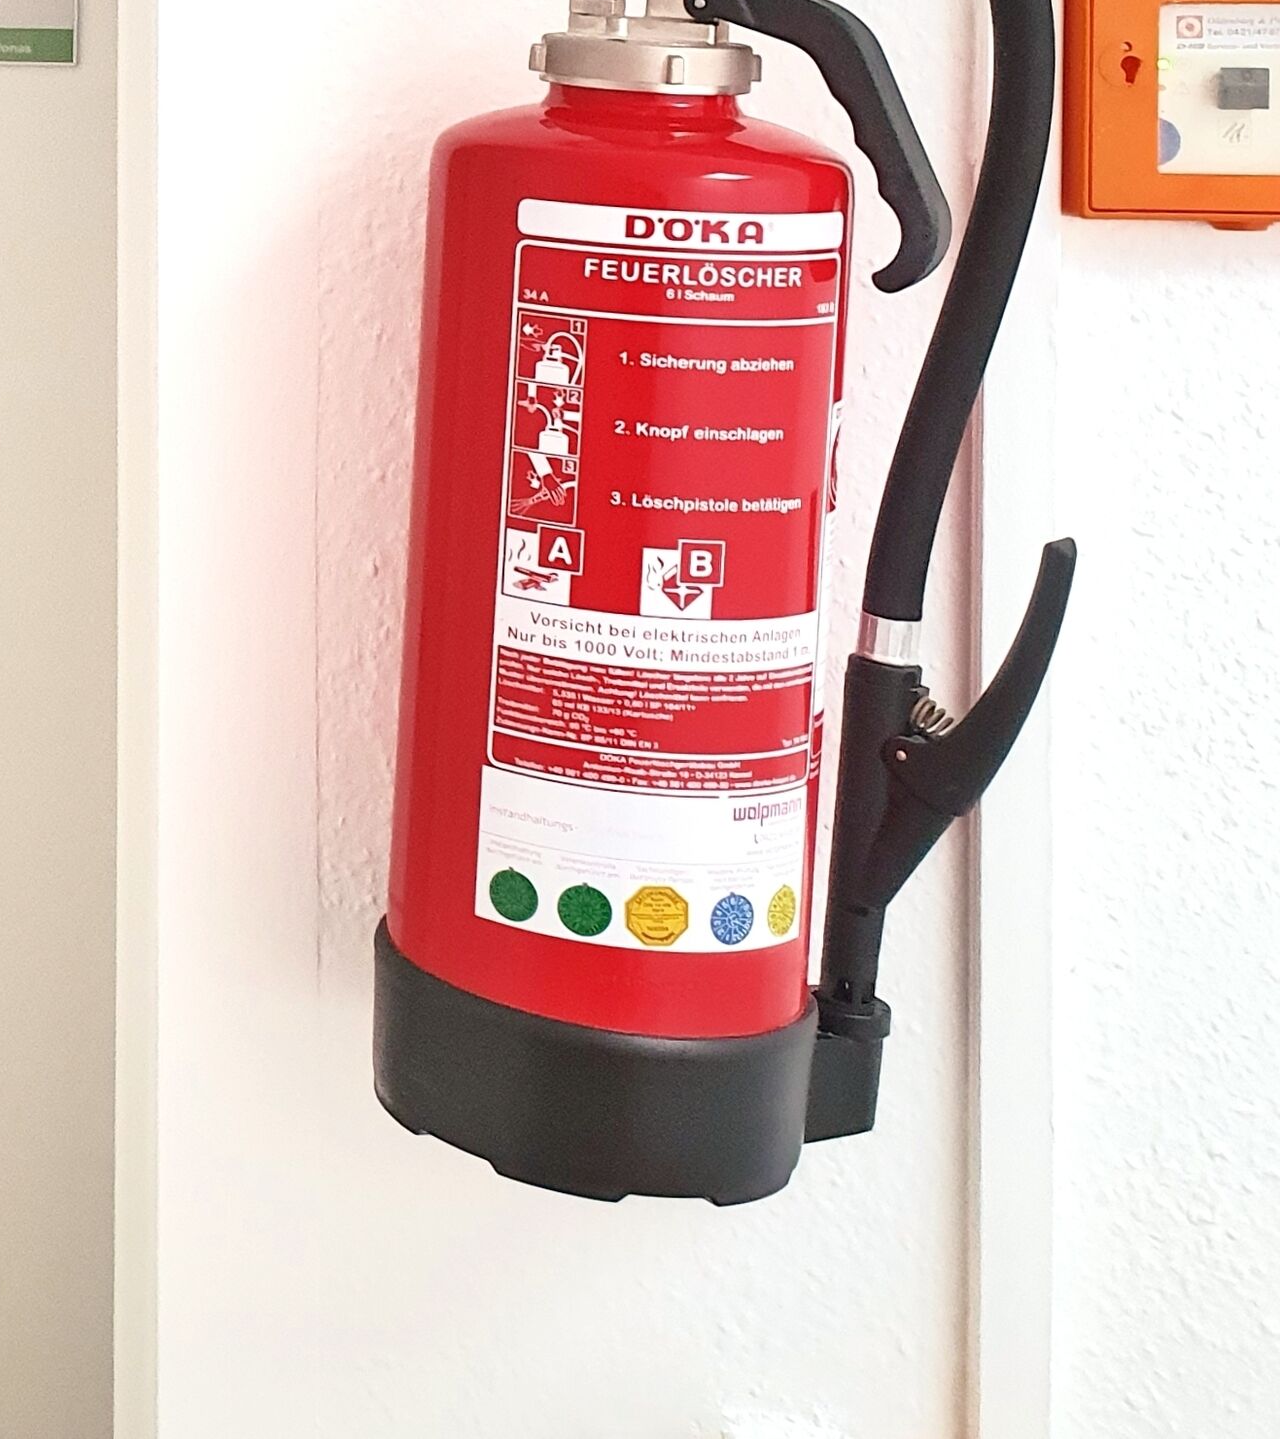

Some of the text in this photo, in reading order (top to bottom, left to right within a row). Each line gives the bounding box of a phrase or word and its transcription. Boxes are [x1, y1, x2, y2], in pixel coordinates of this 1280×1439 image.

[584, 258, 802, 288] FEUERLÖSCHER
[539, 291, 549, 302] A
[666, 289, 675, 300] 6
[684, 290, 735, 303] Schaum
[620, 352, 795, 375] 1. Sicherung abziehen
[614, 421, 784, 444] 2. Knopf einschlagen
[610, 492, 802, 513] 3. Löschpistole betätigen
[548, 536, 572, 565] A
[690, 550, 713, 577] B
[530, 611, 801, 643] Vorsicht bei elektrischen Anlagen
[507, 625, 536, 643] Nur
[542, 634, 567, 649] bis
[575, 640, 617, 656] 1000
[670, 648, 788, 663] Mindestabstand
